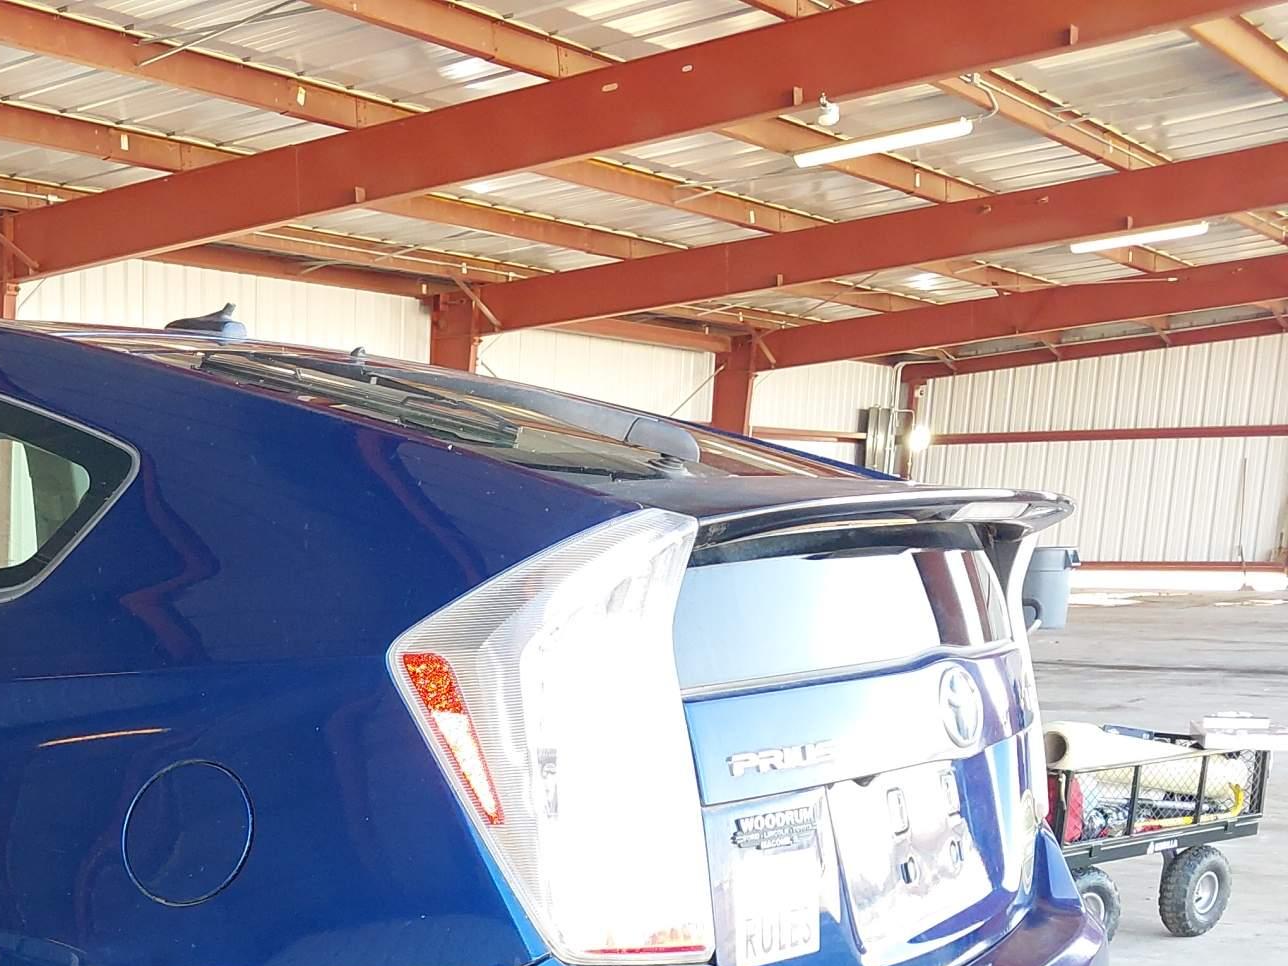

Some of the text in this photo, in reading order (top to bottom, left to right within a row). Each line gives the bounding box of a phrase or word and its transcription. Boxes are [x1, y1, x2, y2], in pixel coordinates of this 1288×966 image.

[726, 738, 838, 777] PRIUS
[739, 807, 814, 833] WOODRUM
[744, 906, 811, 959] RULES
